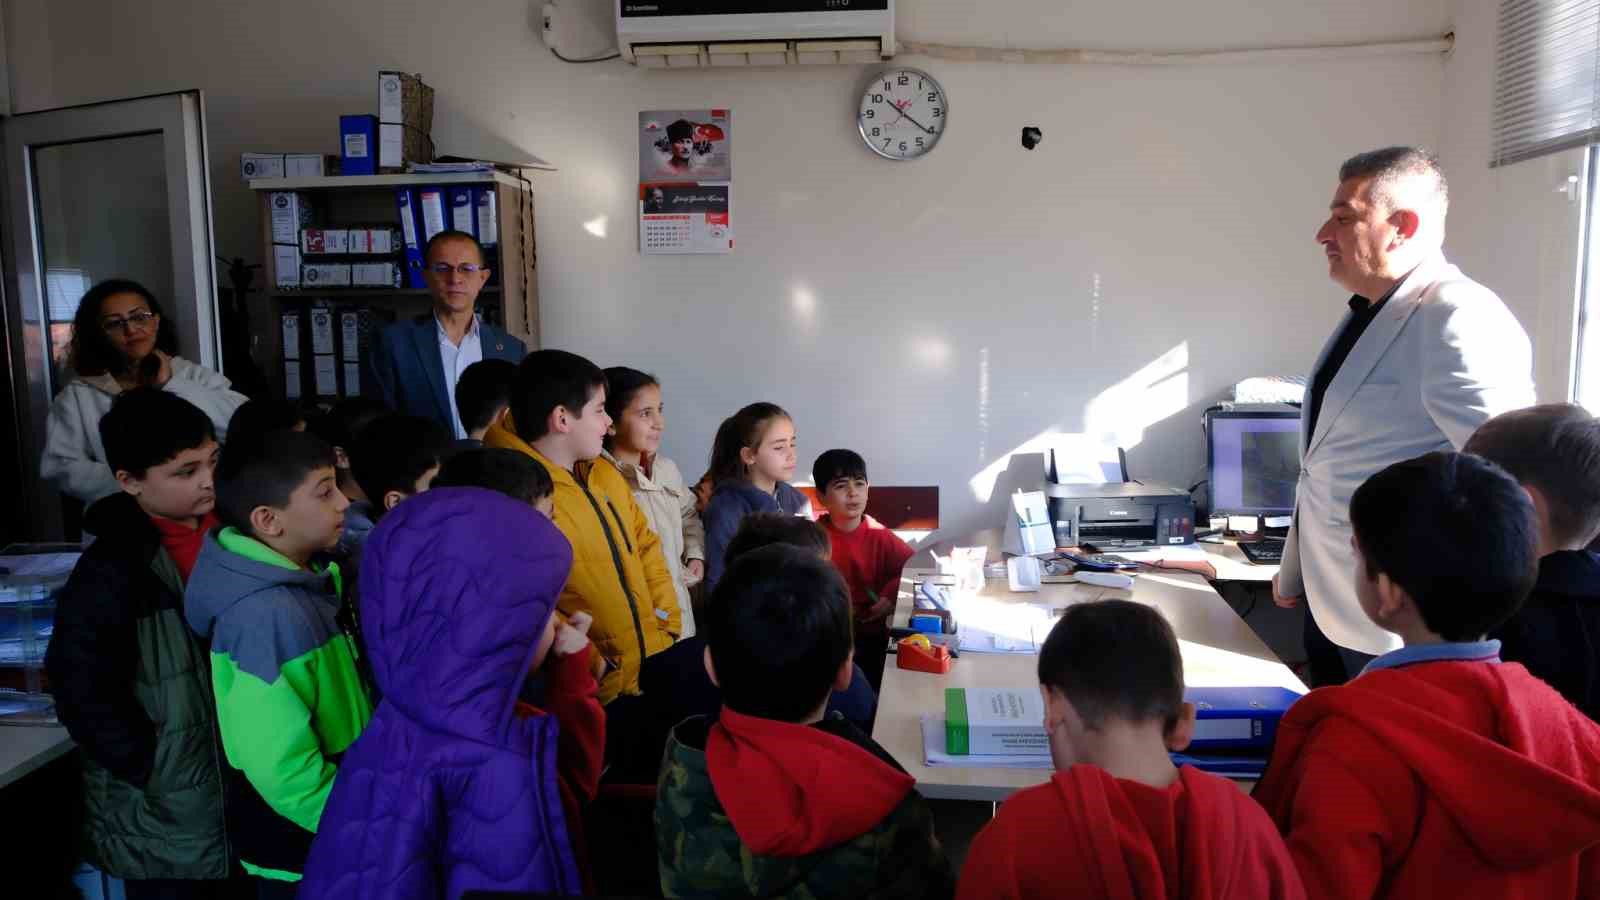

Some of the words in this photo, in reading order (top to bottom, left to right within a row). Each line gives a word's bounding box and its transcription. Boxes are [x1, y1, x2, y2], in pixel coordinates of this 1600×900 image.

[897, 76, 909, 86] 12
[918, 81, 922, 90] 1
[884, 81, 891, 91] 11
[871, 94, 883, 103] 10
[927, 92, 936, 102] 2
[866, 109, 874, 118] 9
[932, 108, 940, 117] 3
[872, 127, 880, 136] 8
[927, 126, 935, 134] 4
[883, 138, 891, 149] 7
[915, 137, 923, 146] 5
[898, 142, 907, 151] 6
